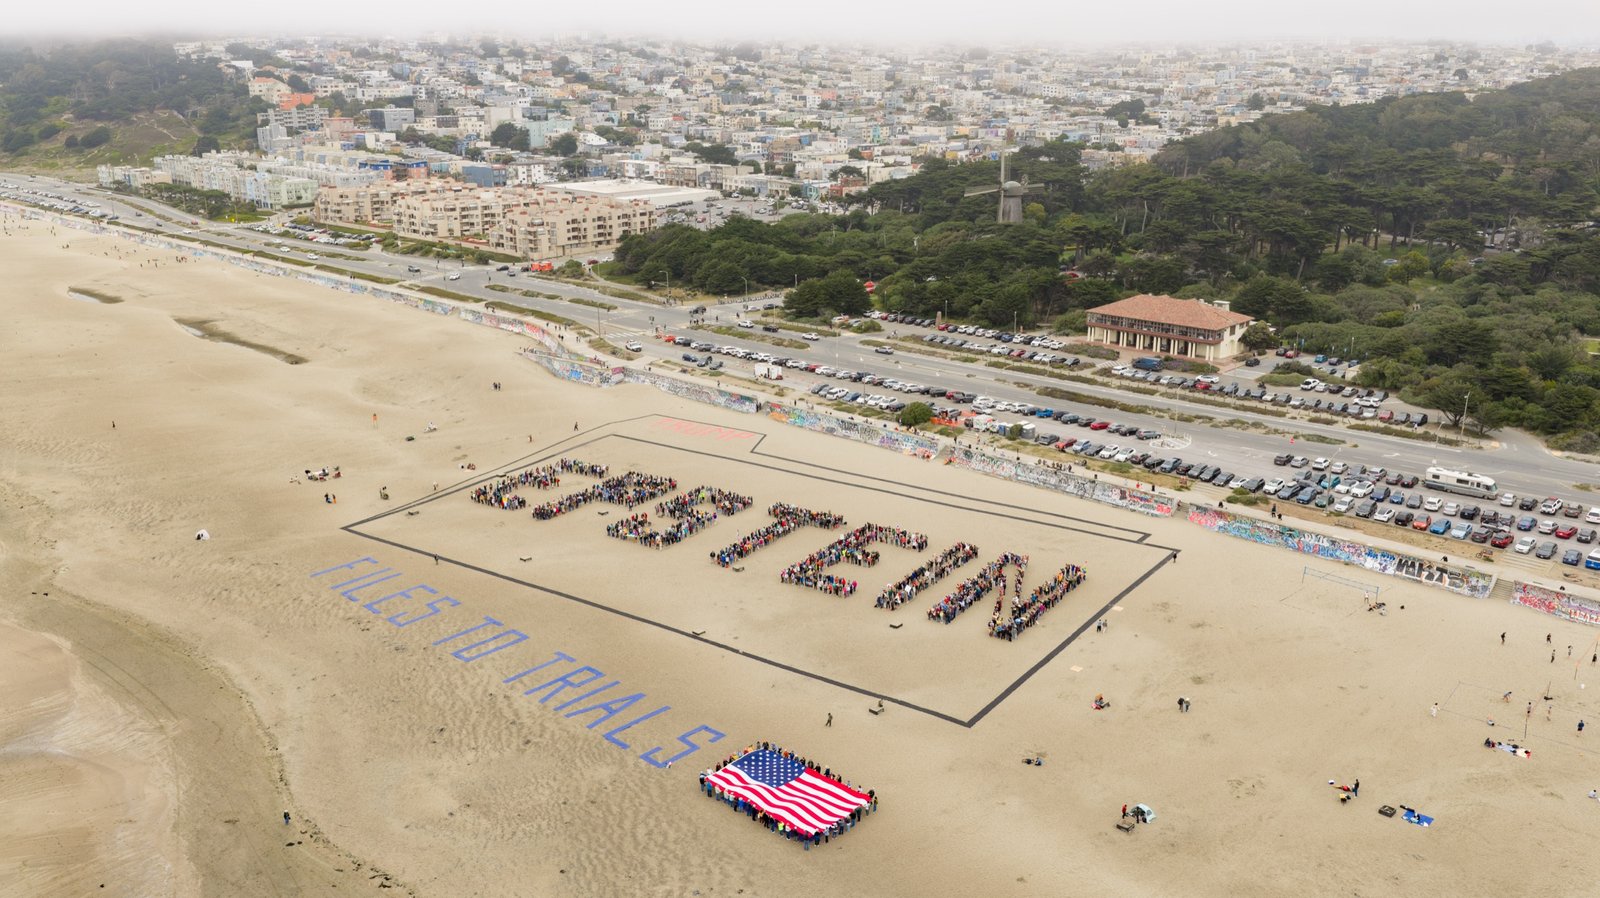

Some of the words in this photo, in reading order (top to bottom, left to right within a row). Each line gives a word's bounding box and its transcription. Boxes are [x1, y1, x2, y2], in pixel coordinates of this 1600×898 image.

[654, 416, 755, 443] TRUMP
[470, 457, 1087, 642] EPSTEIN
[310, 556, 461, 628] FILES
[432, 615, 530, 663] TO
[503, 651, 727, 768] TRIALS
